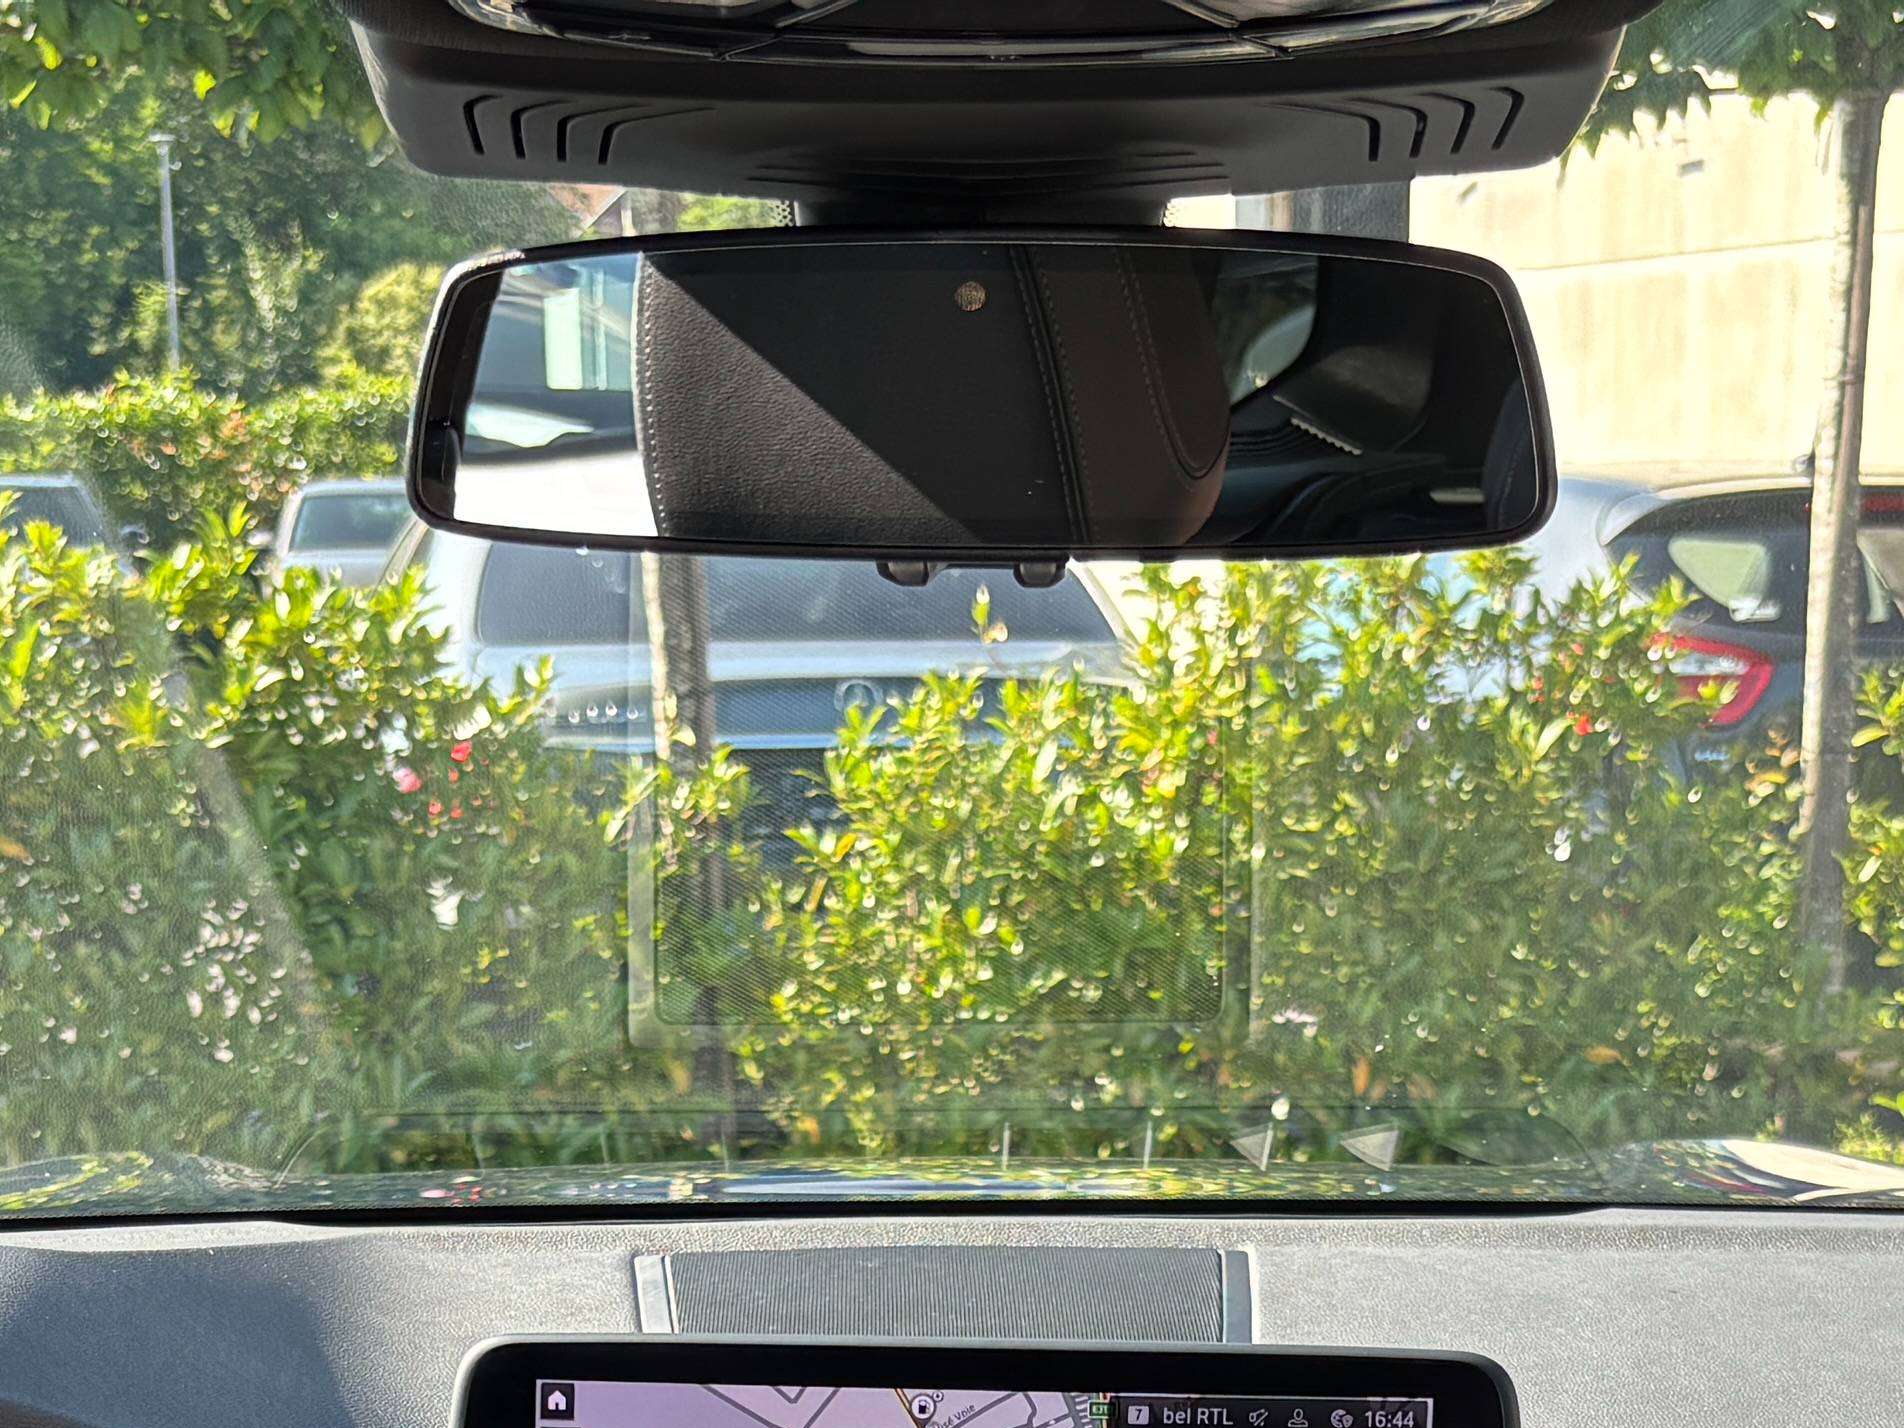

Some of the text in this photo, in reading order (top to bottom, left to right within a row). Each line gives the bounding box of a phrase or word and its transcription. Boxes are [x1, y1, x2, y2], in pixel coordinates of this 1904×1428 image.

[1133, 1408, 1143, 1422] 7
[1163, 1407, 1234, 1426] bel RTL
[1364, 1411, 1415, 1428] 16:44
